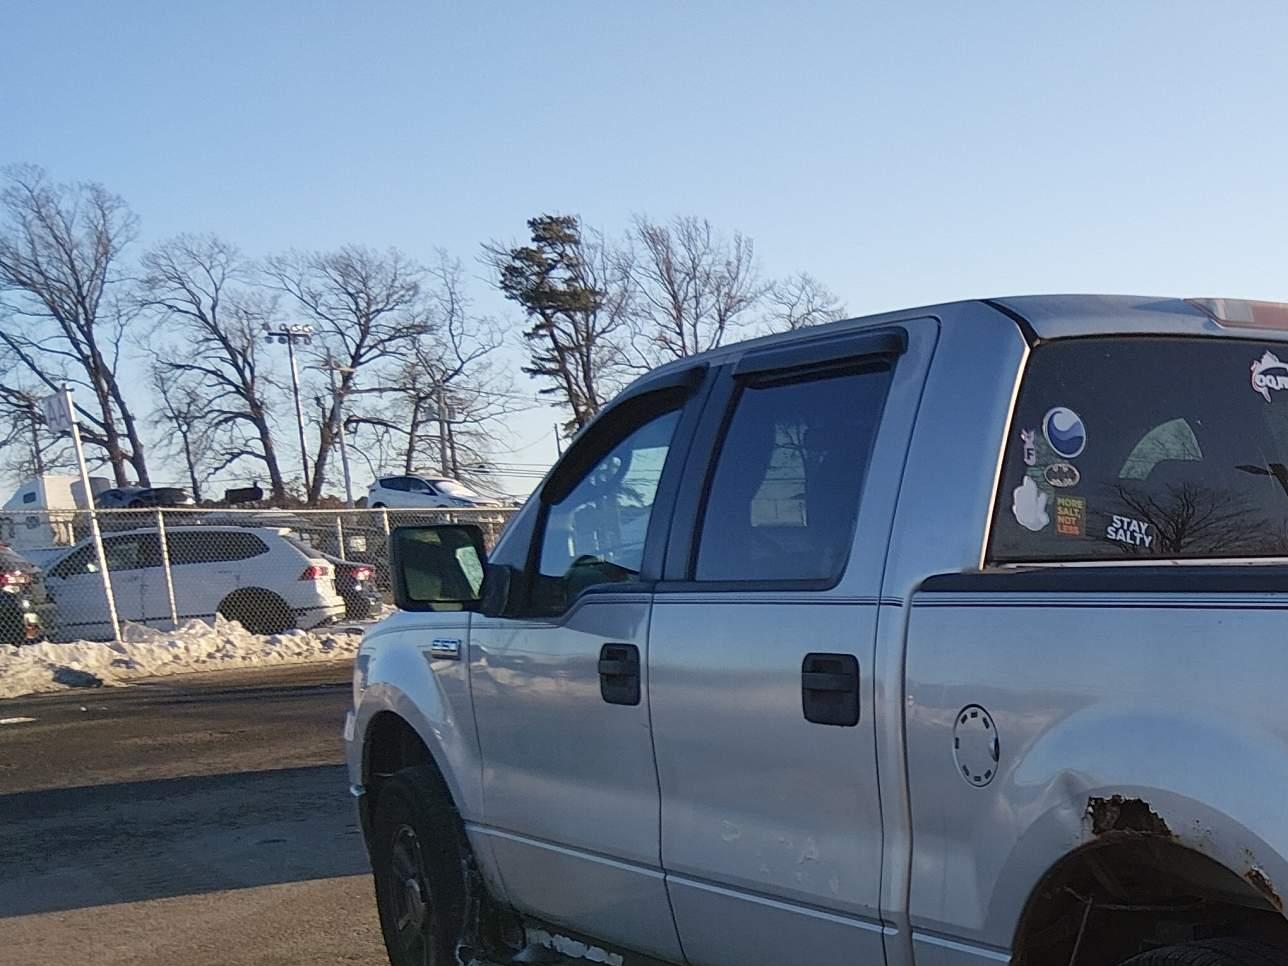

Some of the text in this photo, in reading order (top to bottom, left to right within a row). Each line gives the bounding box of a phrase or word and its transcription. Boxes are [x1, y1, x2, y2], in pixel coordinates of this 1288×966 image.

[1057, 498, 1084, 509] MORE
[1057, 516, 1077, 525] NOT
[1112, 515, 1149, 534] STAY
[1106, 526, 1153, 548] SALTY
